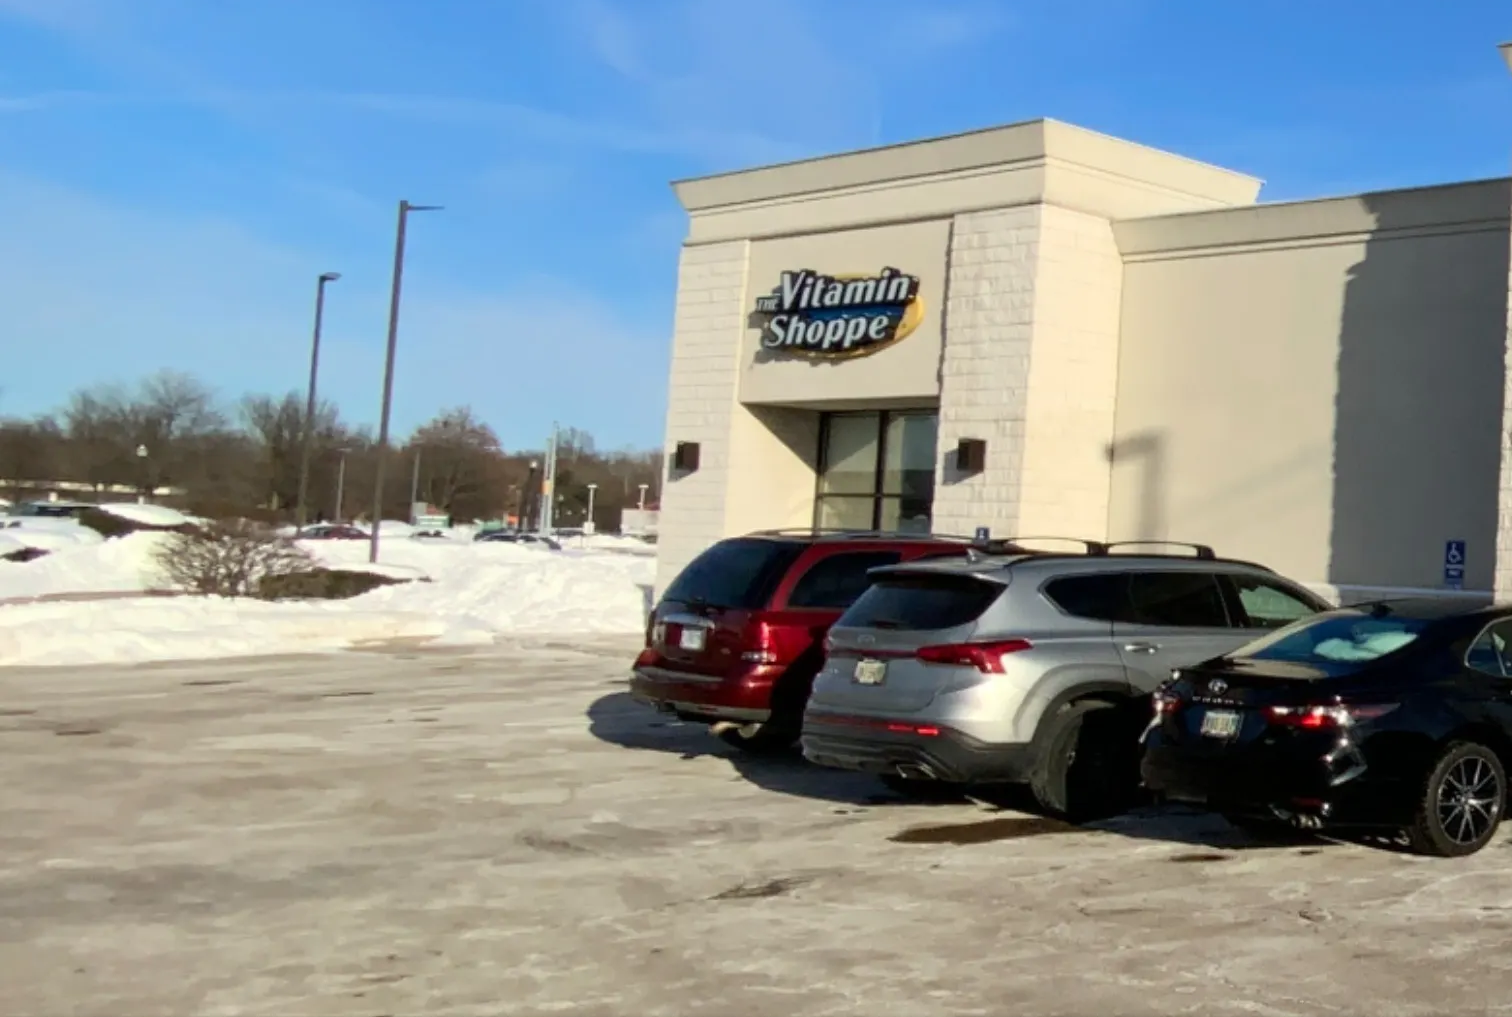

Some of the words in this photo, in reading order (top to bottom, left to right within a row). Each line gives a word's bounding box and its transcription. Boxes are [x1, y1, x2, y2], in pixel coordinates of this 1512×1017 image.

[756, 298, 778, 312] THE
[780, 267, 912, 310] Vitamin
[764, 313, 889, 350] Shoppe
